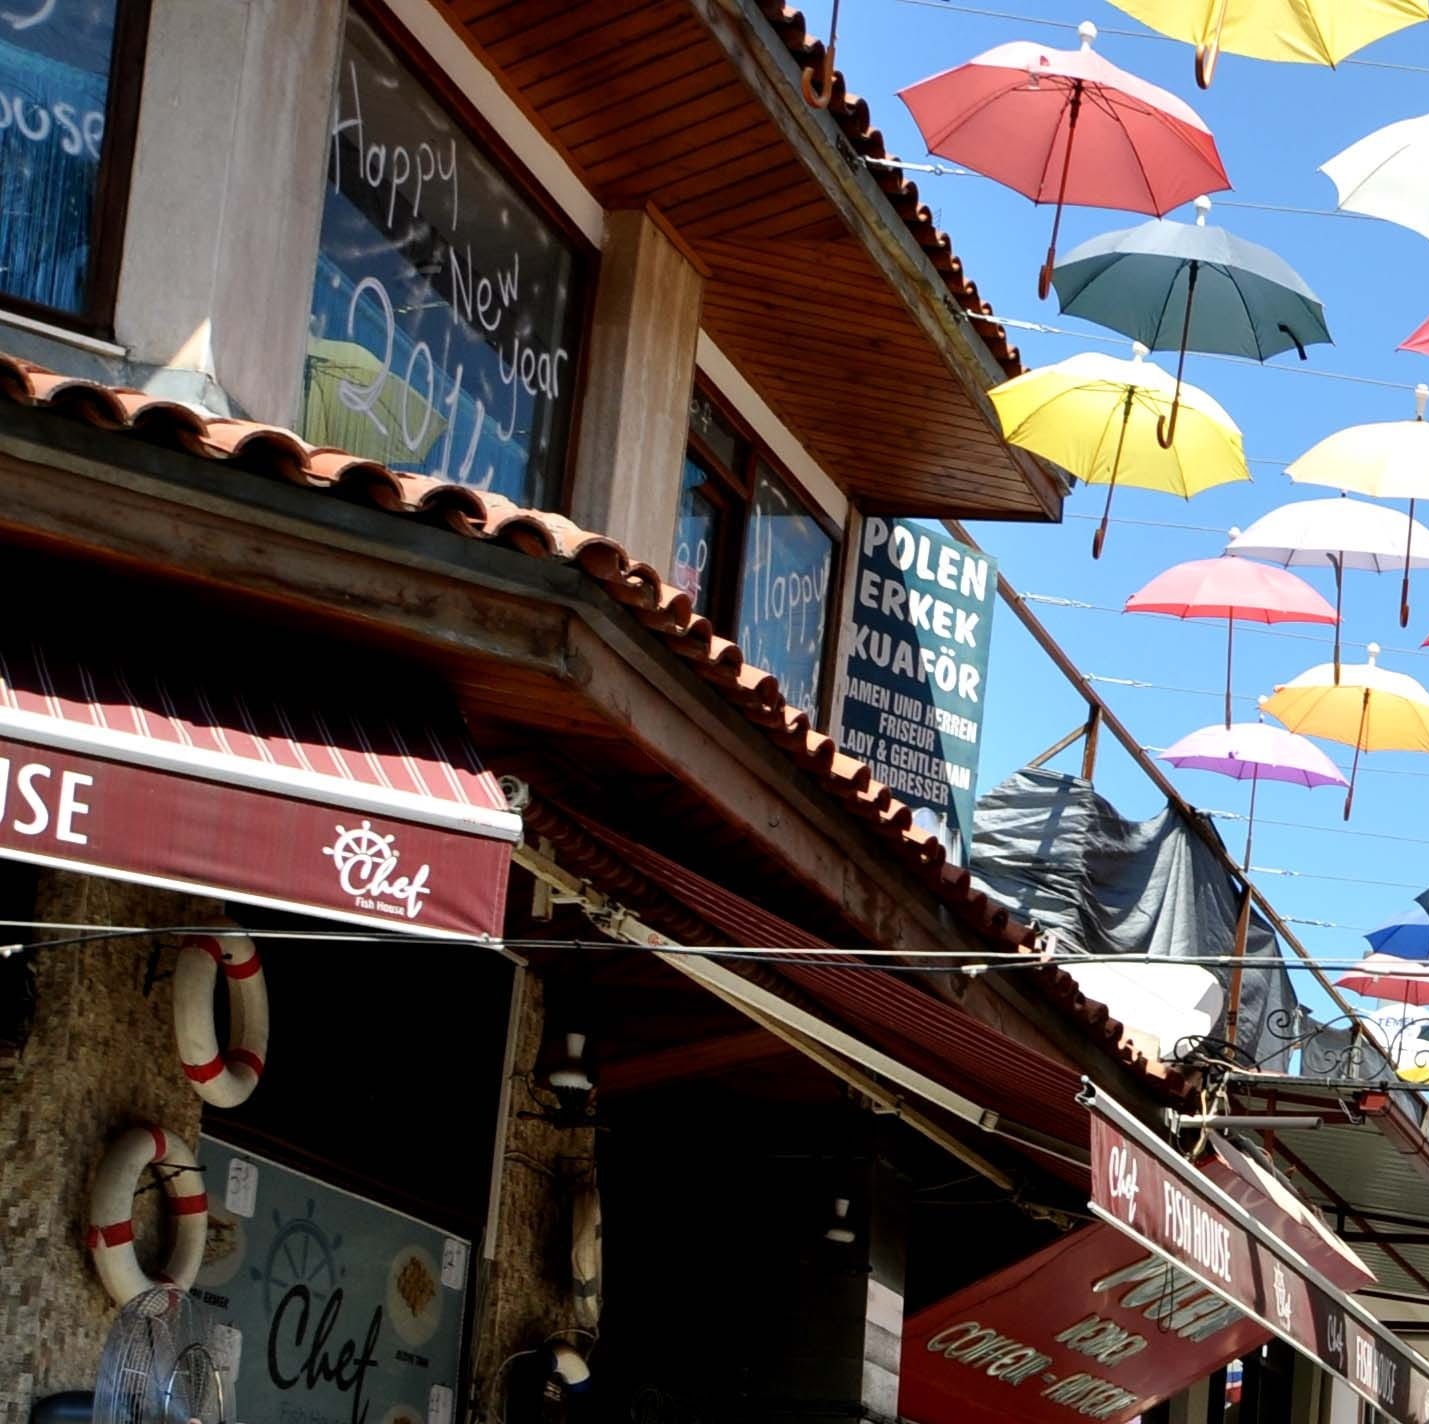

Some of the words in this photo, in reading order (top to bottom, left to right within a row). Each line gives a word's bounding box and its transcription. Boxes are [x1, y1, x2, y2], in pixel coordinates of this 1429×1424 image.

[331, 61, 458, 230] Happy
[449, 244, 519, 331] New
[863, 516, 989, 602] POLEN
[859, 568, 981, 649] ERKEK
[850, 622, 981, 703] KUAFÖR
[840, 725, 874, 754] LADY
[877, 739, 887, 762] &
[890, 740, 971, 791] GENTLEMAN
[879, 712, 935, 752] FRISEUR
[893, 691, 922, 722] UND
[926, 703, 978, 744] HERREN
[340, 855, 432, 919] Chef
[355, 896, 375, 910] Fish
[376, 900, 405, 915] House
[1108, 1142, 1140, 1224] Chef
[1163, 1180, 1193, 1256] FISH
[1191, 1203, 1232, 1283] HOUSE
[1356, 1335, 1378, 1393] FISH
[1376, 1349, 1397, 1406] HOUSE
